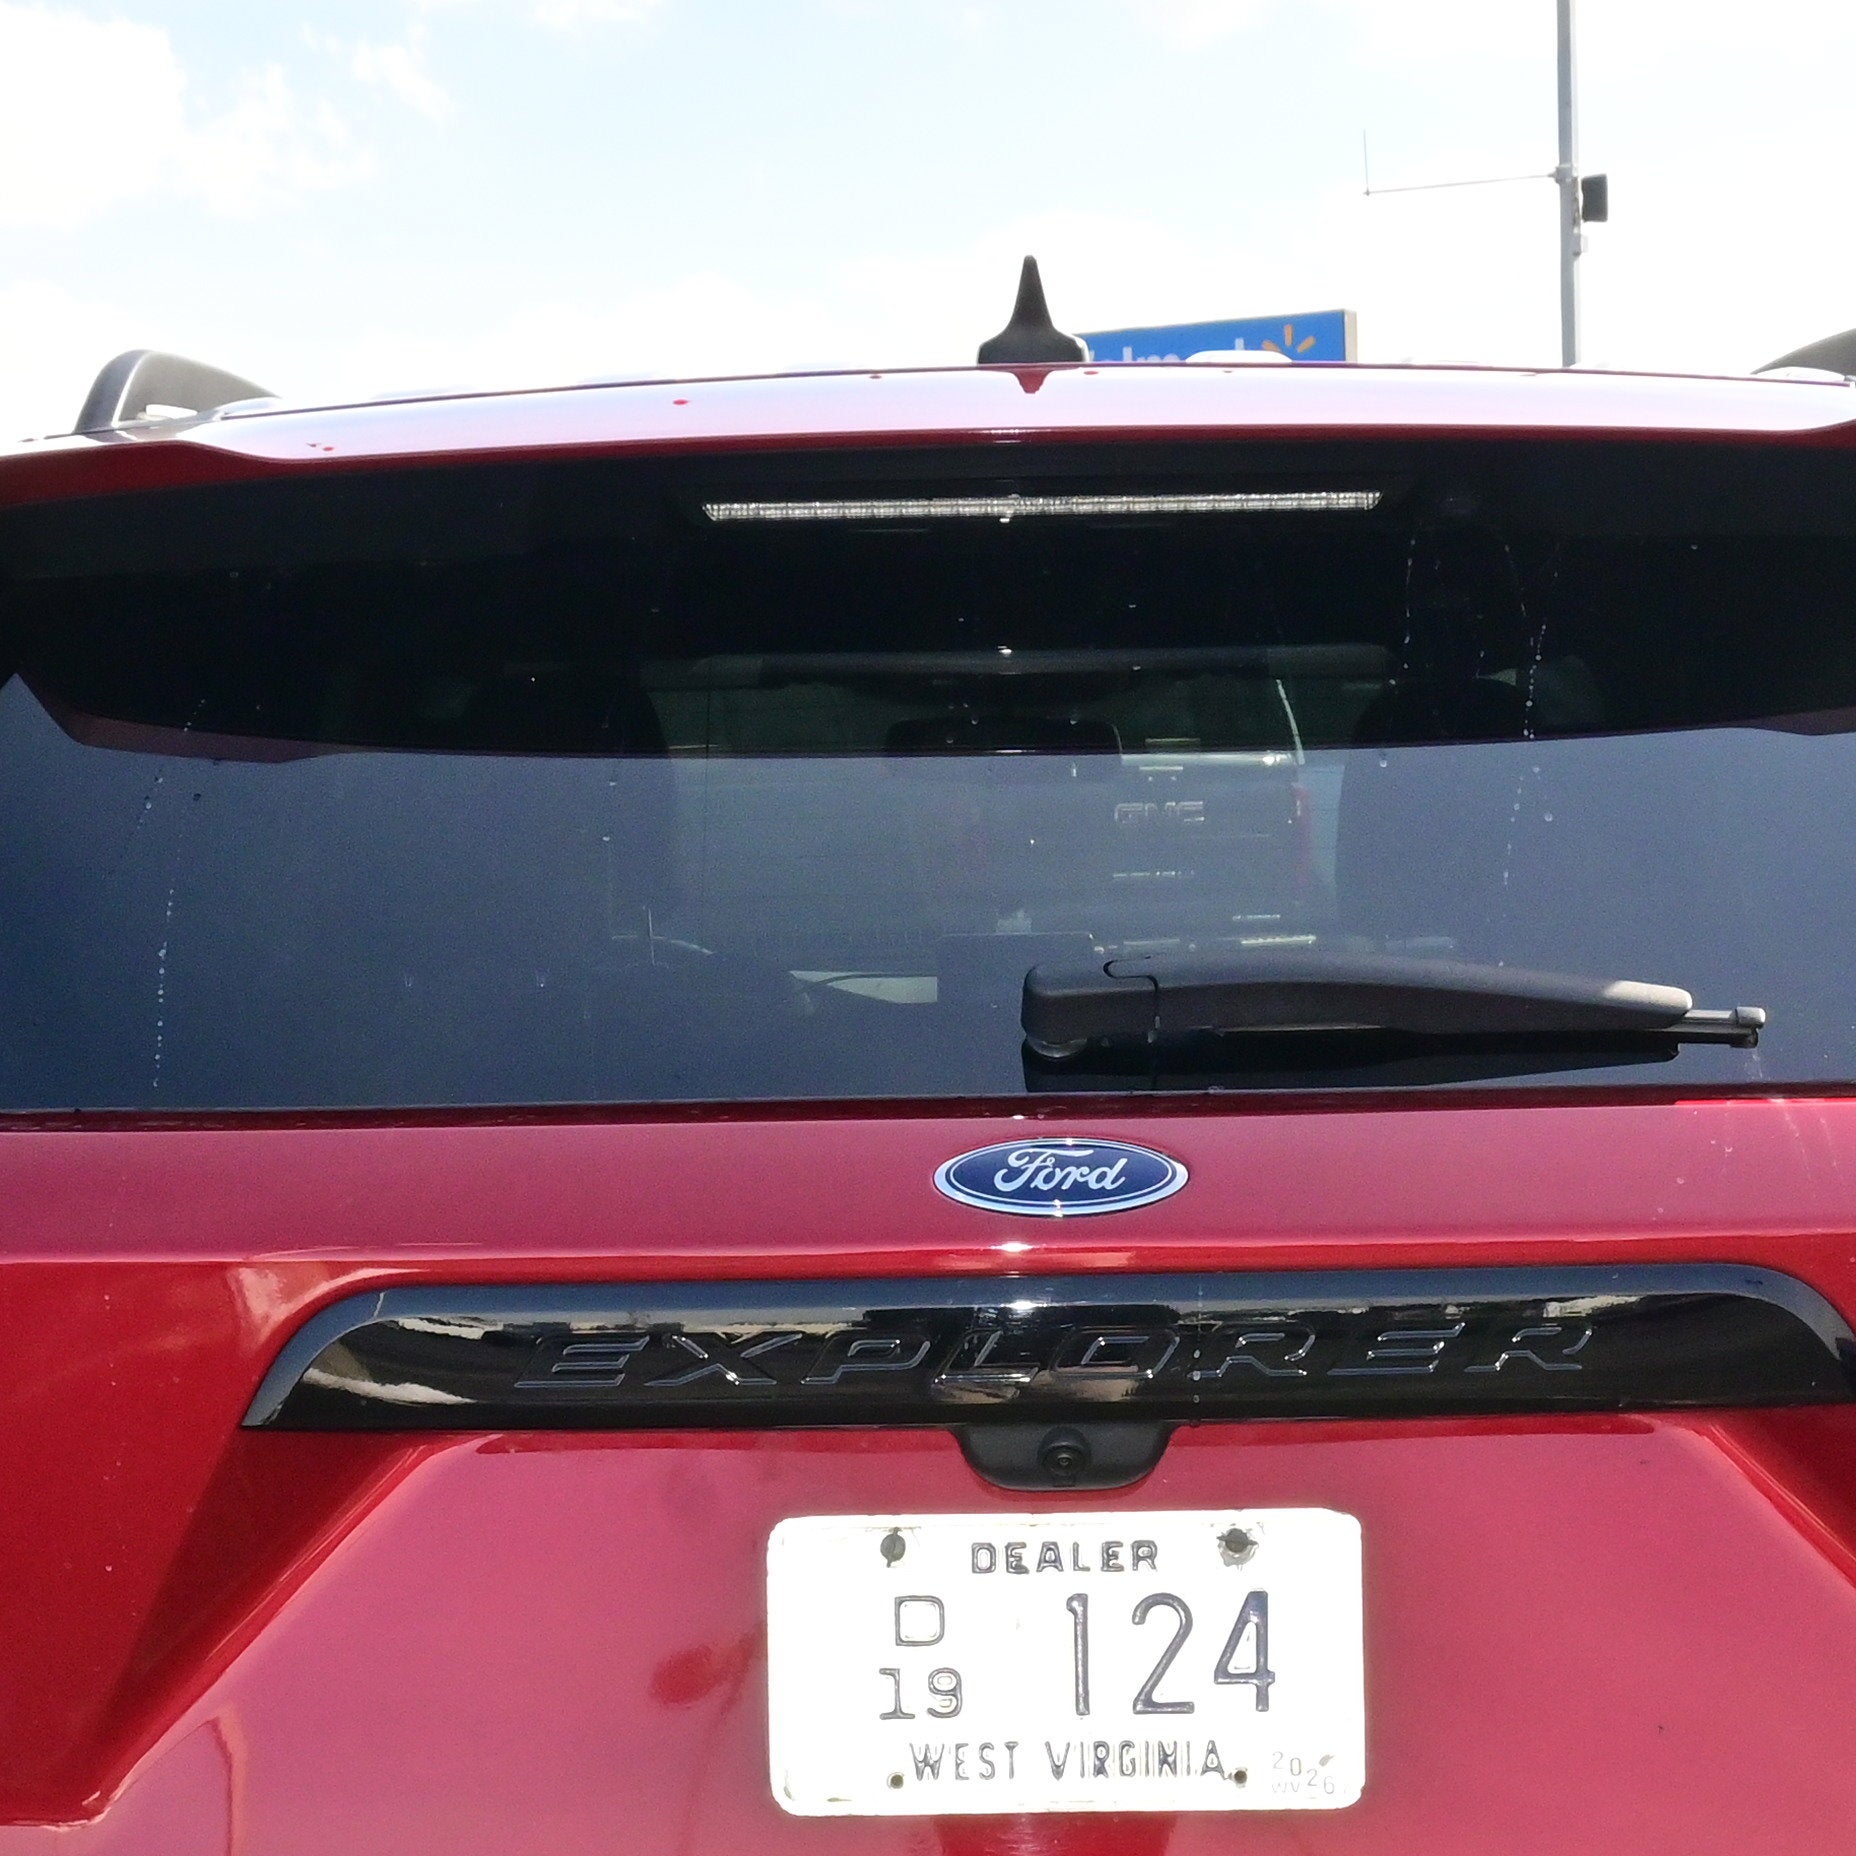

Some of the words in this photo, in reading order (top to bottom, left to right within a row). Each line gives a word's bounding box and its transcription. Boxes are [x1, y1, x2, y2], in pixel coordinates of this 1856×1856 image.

[994, 1148, 1128, 1192] Ford
[514, 1321, 1594, 1389] EXPLORER
[971, 1541, 1159, 1574] DEALER
[895, 1595, 945, 1647] D
[1065, 1590, 1276, 1716] 124
[879, 1667, 963, 1720] 19
[909, 1741, 1019, 1781] WEST
[1044, 1739, 1227, 1780] VIRGINIA
